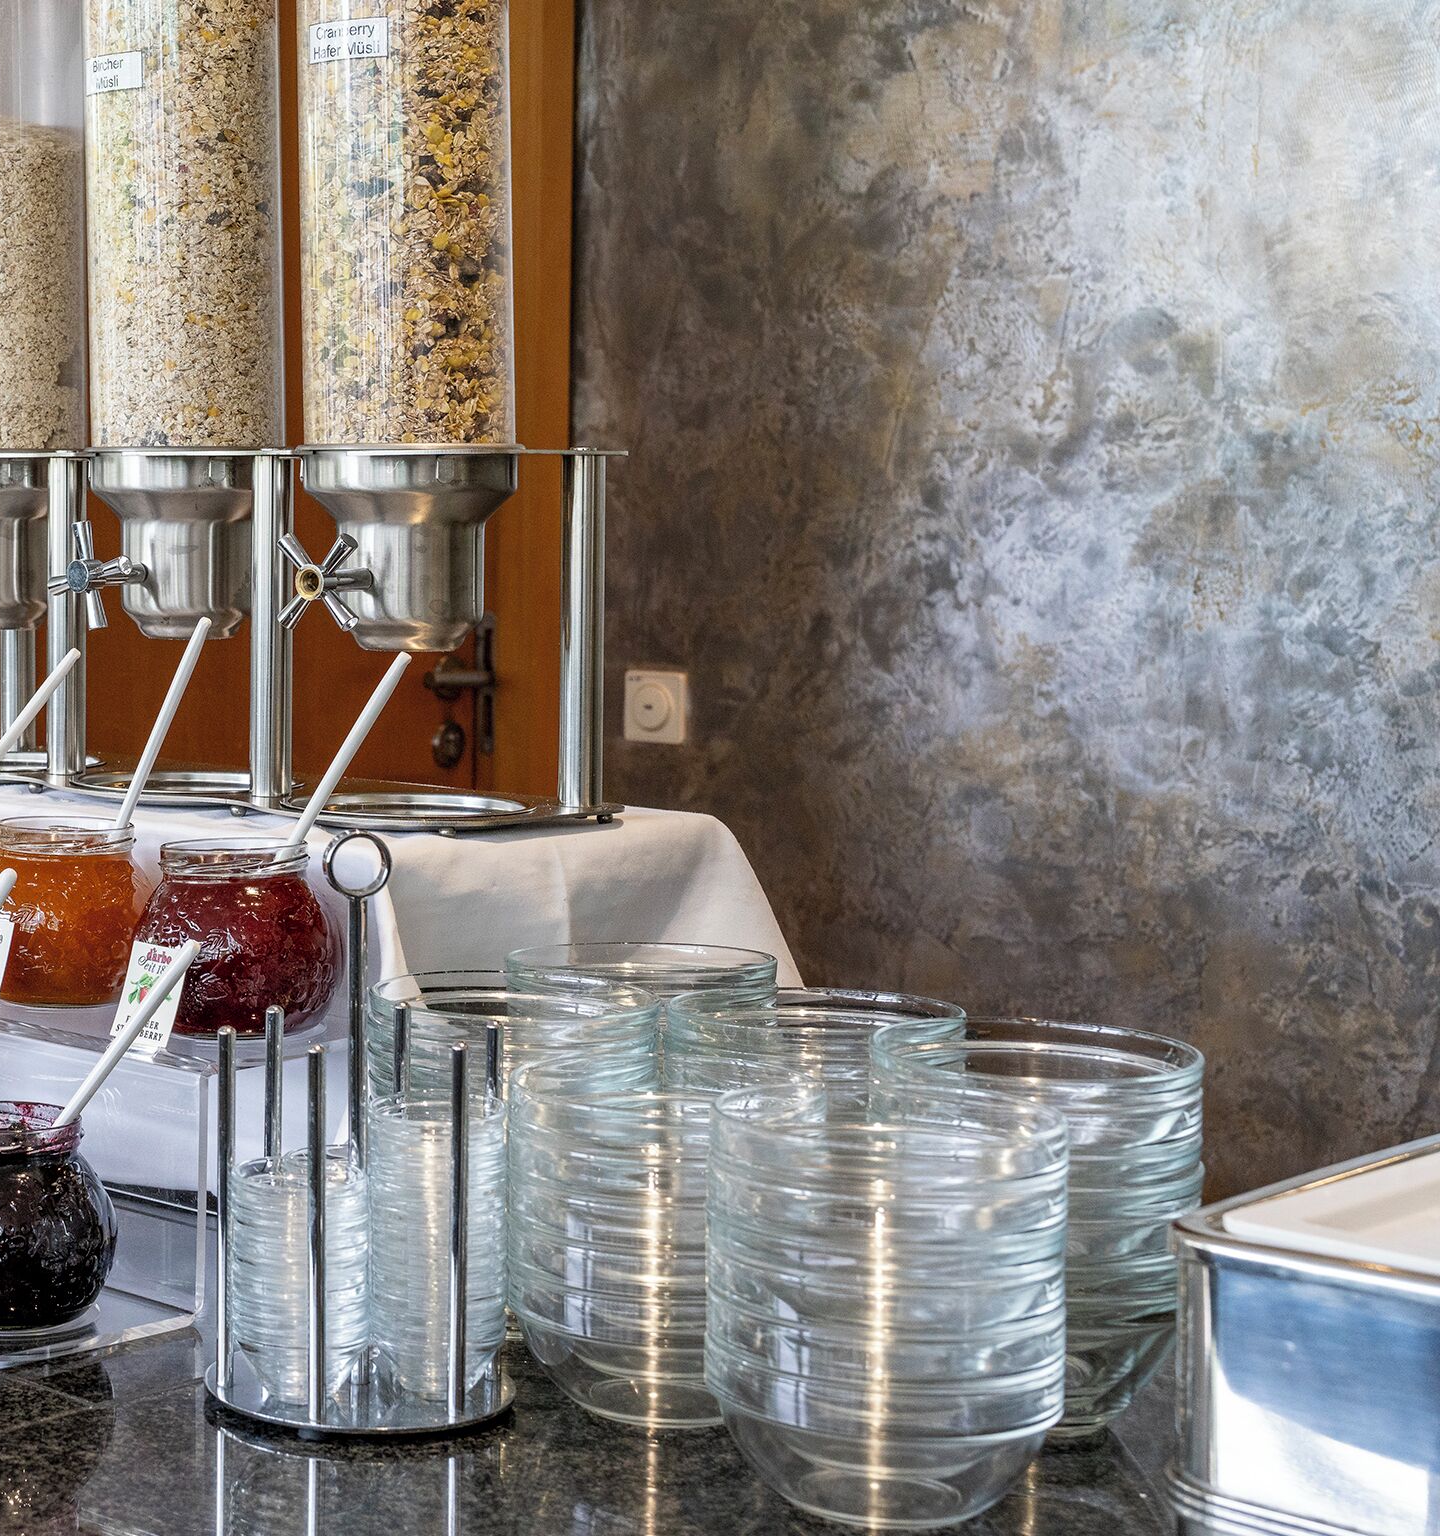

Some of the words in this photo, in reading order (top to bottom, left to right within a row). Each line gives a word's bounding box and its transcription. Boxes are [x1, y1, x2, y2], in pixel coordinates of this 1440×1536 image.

[316, 24, 375, 40] Cranerry
[313, 44, 341, 60] Hafer
[92, 58, 124, 73] Bircher
[96, 75, 119, 89] Müsli
[137, 955, 157, 973] Seit
